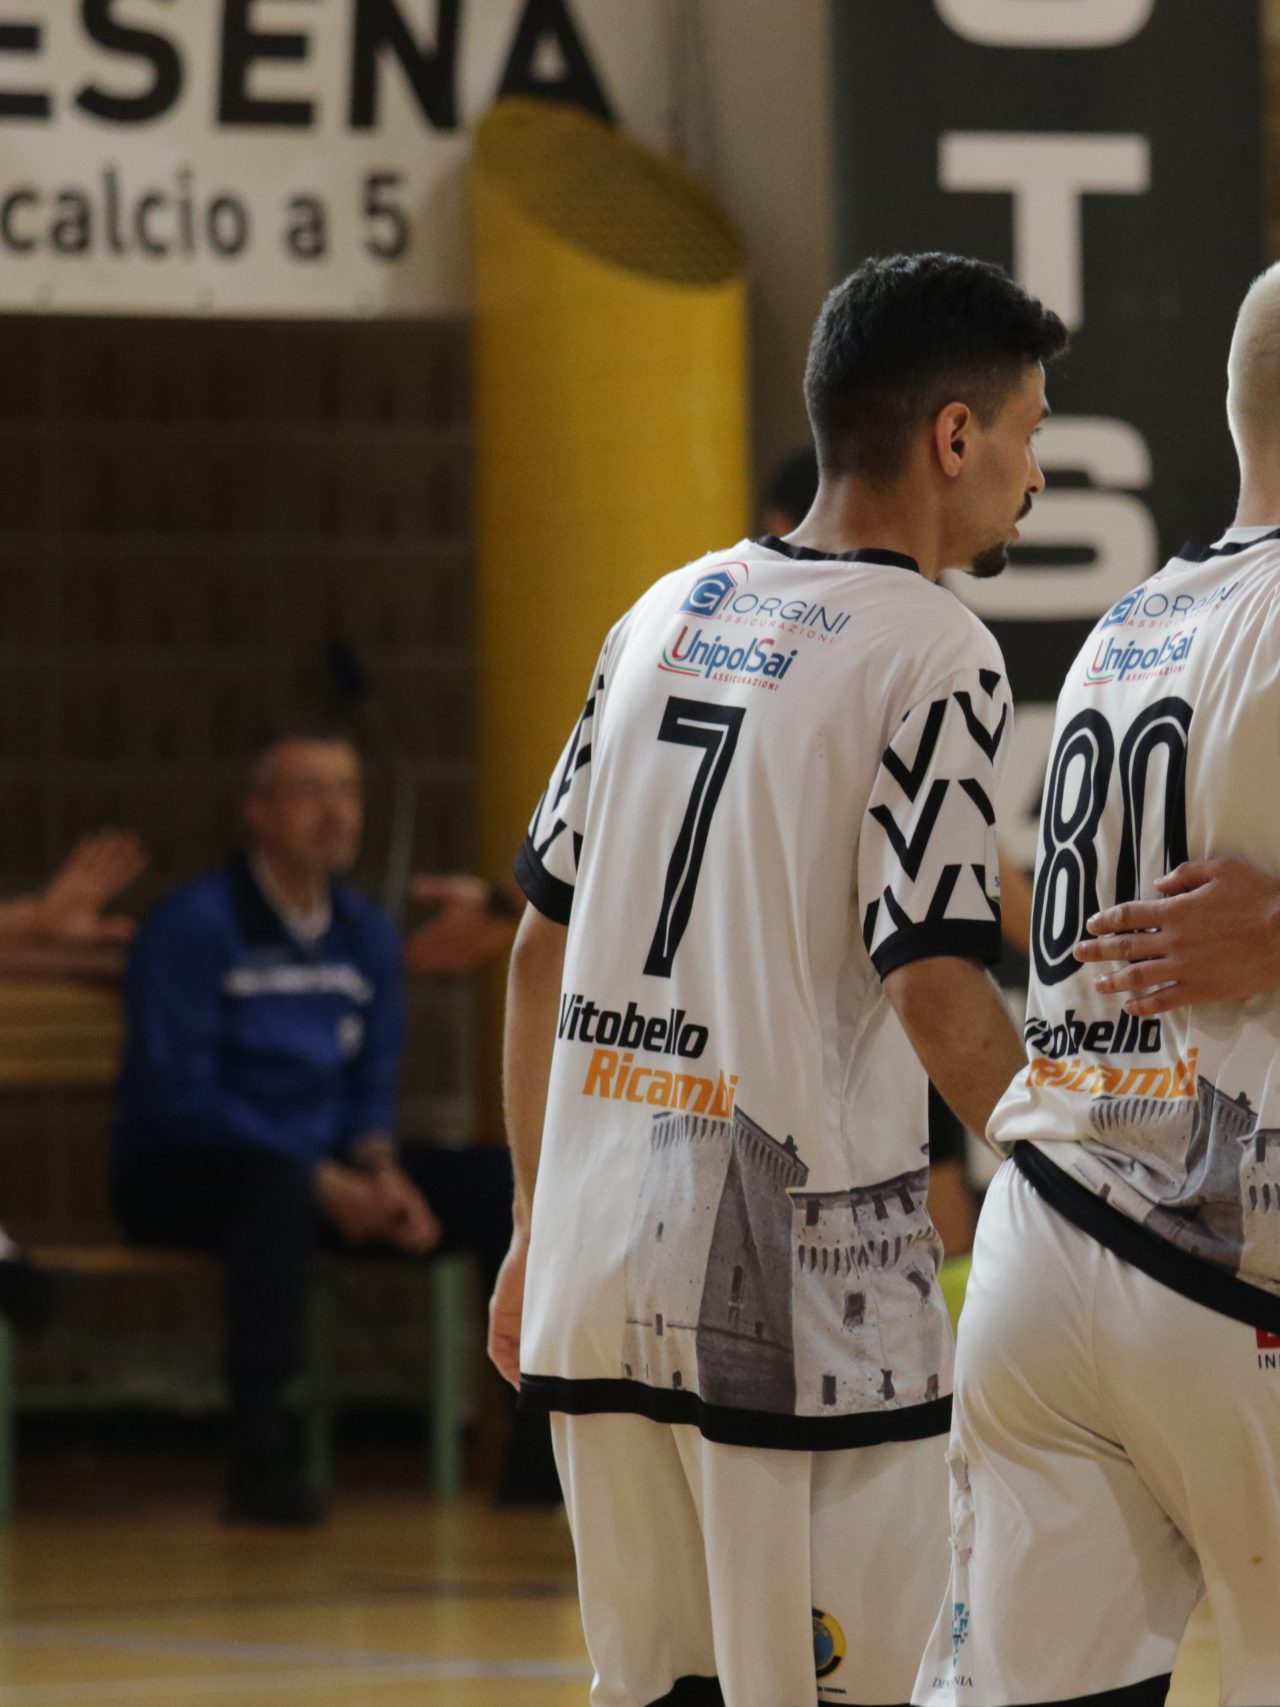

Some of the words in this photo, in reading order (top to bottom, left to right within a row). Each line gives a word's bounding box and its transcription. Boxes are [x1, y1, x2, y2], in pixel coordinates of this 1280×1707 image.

[0, 165, 250, 258] calcio
[286, 195, 328, 260] a
[364, 174, 411, 262] 5
[689, 579, 851, 634] GIORGINI
[716, 613, 835, 644] ASSICURAZIONI
[672, 625, 798, 679] UnipolSai
[713, 673, 779, 692] ASSICURAZIONI
[1092, 627, 1197, 681] UnipolSai
[643, 695, 746, 978] 7
[1032, 696, 1195, 986] 80
[558, 993, 709, 1060] Vitobello
[582, 1047, 739, 1120] Ricambi
